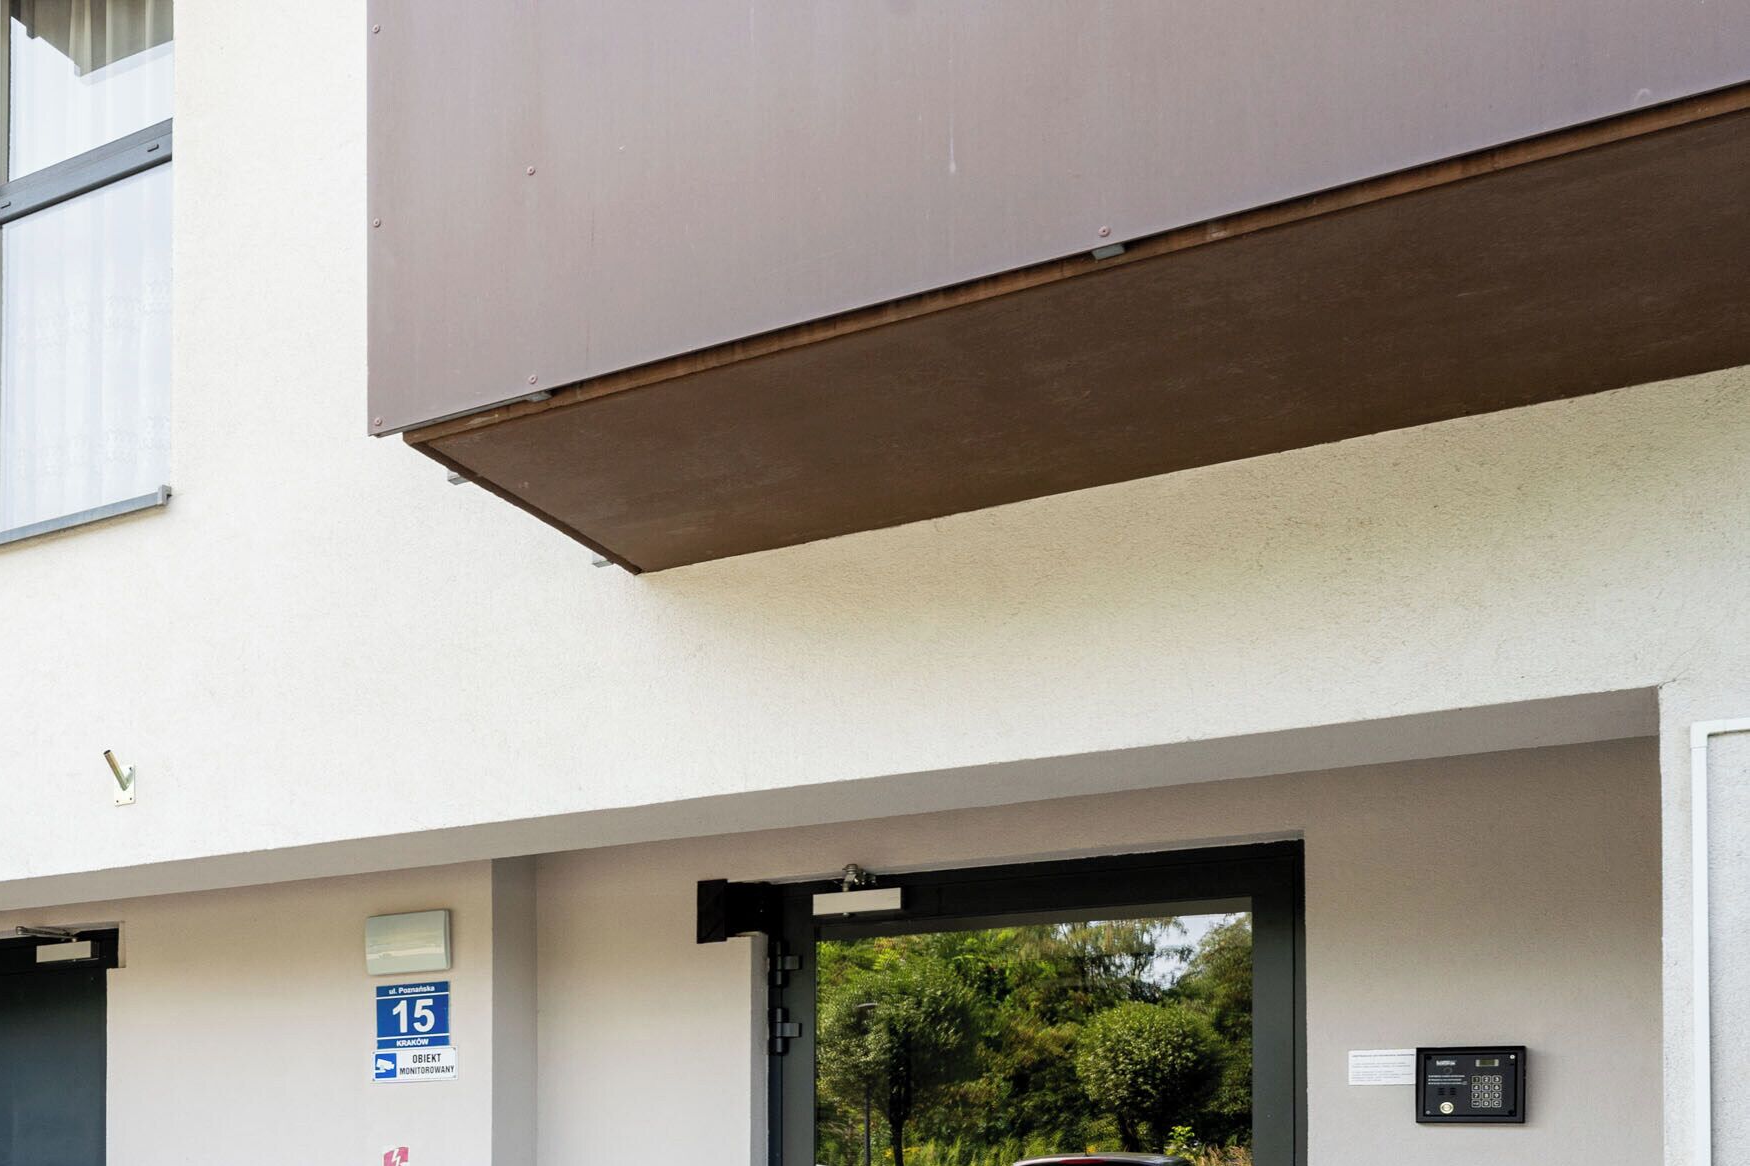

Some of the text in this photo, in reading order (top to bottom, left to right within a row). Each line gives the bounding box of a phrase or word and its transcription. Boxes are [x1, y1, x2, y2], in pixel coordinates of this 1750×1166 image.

[392, 998, 436, 1034] 15
[396, 1038, 430, 1047] KRAKÓW
[412, 1053, 442, 1064] OBIEKT
[399, 1065, 455, 1075] MONITOROWANY
